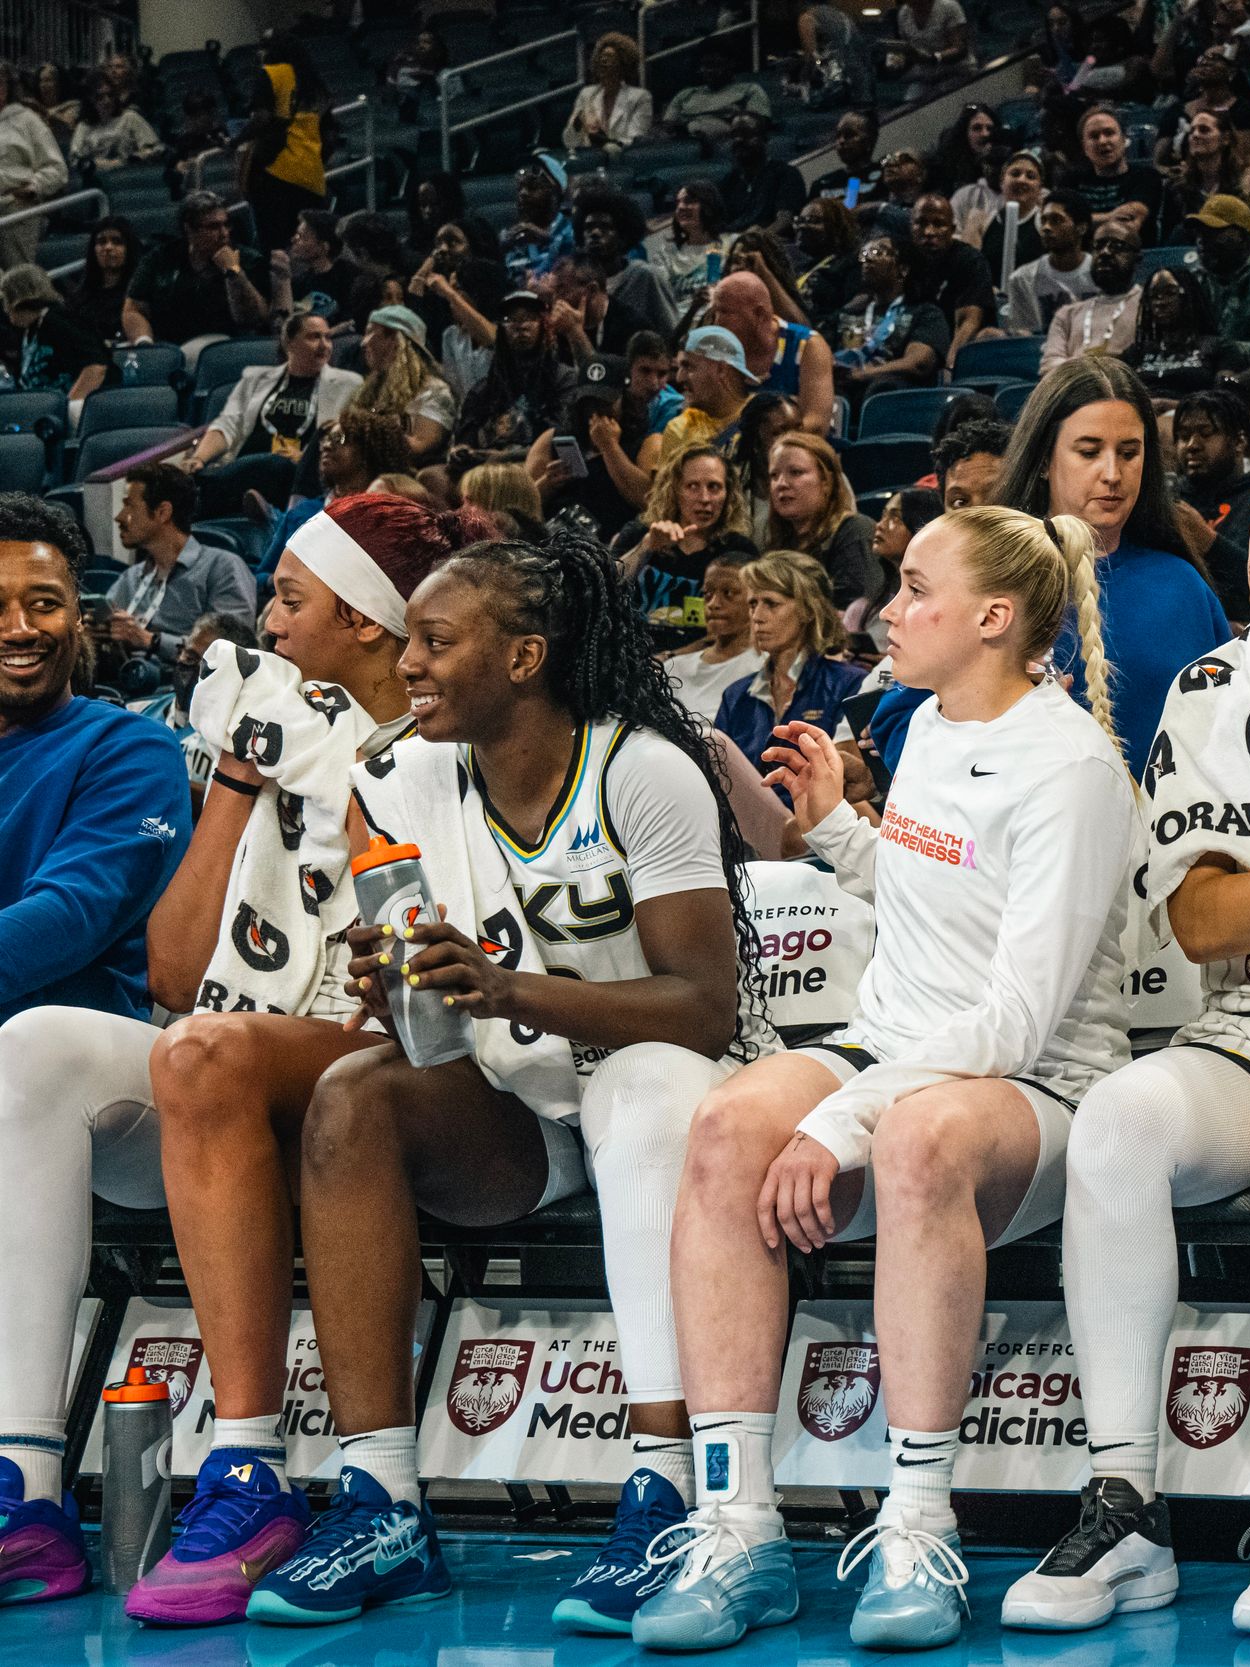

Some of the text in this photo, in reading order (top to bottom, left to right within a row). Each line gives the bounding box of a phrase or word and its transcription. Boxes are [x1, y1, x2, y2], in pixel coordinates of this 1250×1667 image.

[880, 823, 961, 865] WARENESS
[883, 810, 963, 849] REAST HEALTH
[512, 868, 635, 945] KY
[548, 1340, 617, 1352] AT THE
[985, 1343, 1074, 1356] FOREFRO
